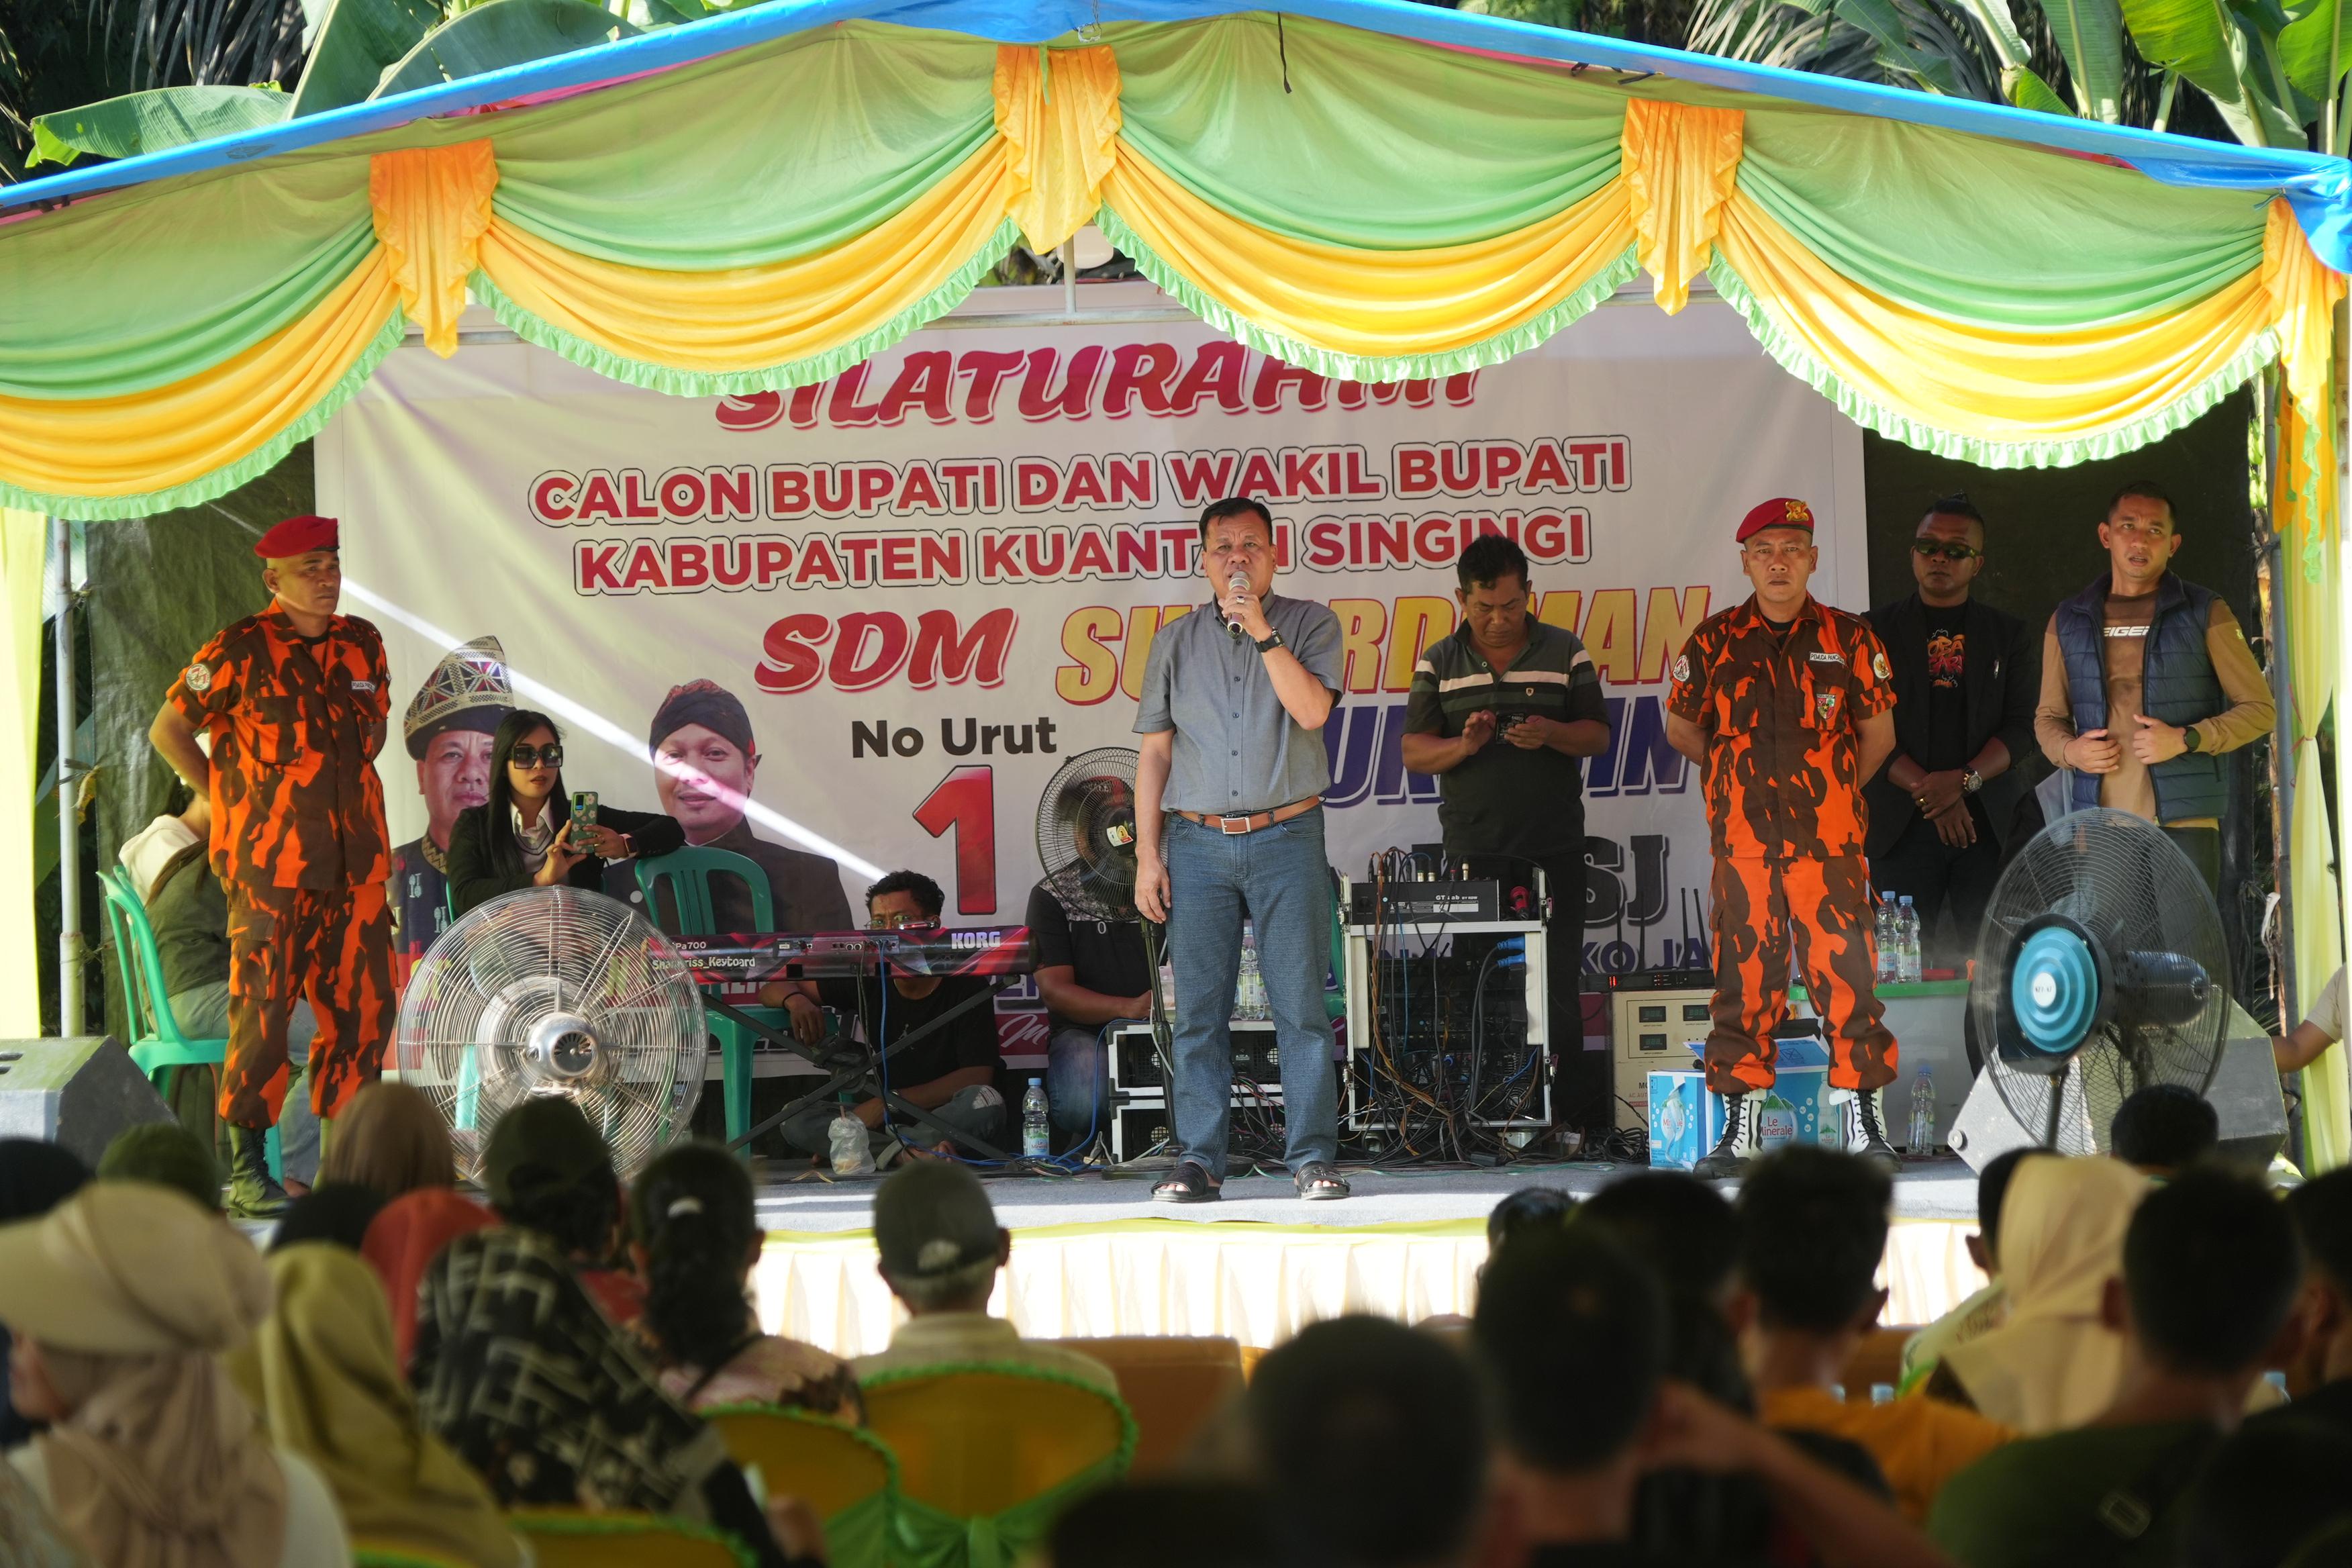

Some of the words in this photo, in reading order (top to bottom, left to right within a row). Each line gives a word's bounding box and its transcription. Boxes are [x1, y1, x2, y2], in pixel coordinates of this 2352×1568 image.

[532, 469, 754, 522] CALON
[770, 461, 1000, 516] BUPATI
[1016, 456, 1154, 511] DAN
[1167, 448, 1383, 504] WAKIL
[1397, 440, 1628, 495] BUPATI
[579, 533, 965, 591] KABUPATEN
[981, 522, 1292, 579] KUANT
[754, 605, 1018, 694] SDM
[852, 720, 924, 758] No
[941, 717, 1057, 756] Urut
[912, 765, 997, 915] 1
[676, 941, 707, 950] Pa700
[950, 931, 1001, 950] KORG
[1767, 1116, 1778, 1127] Le
